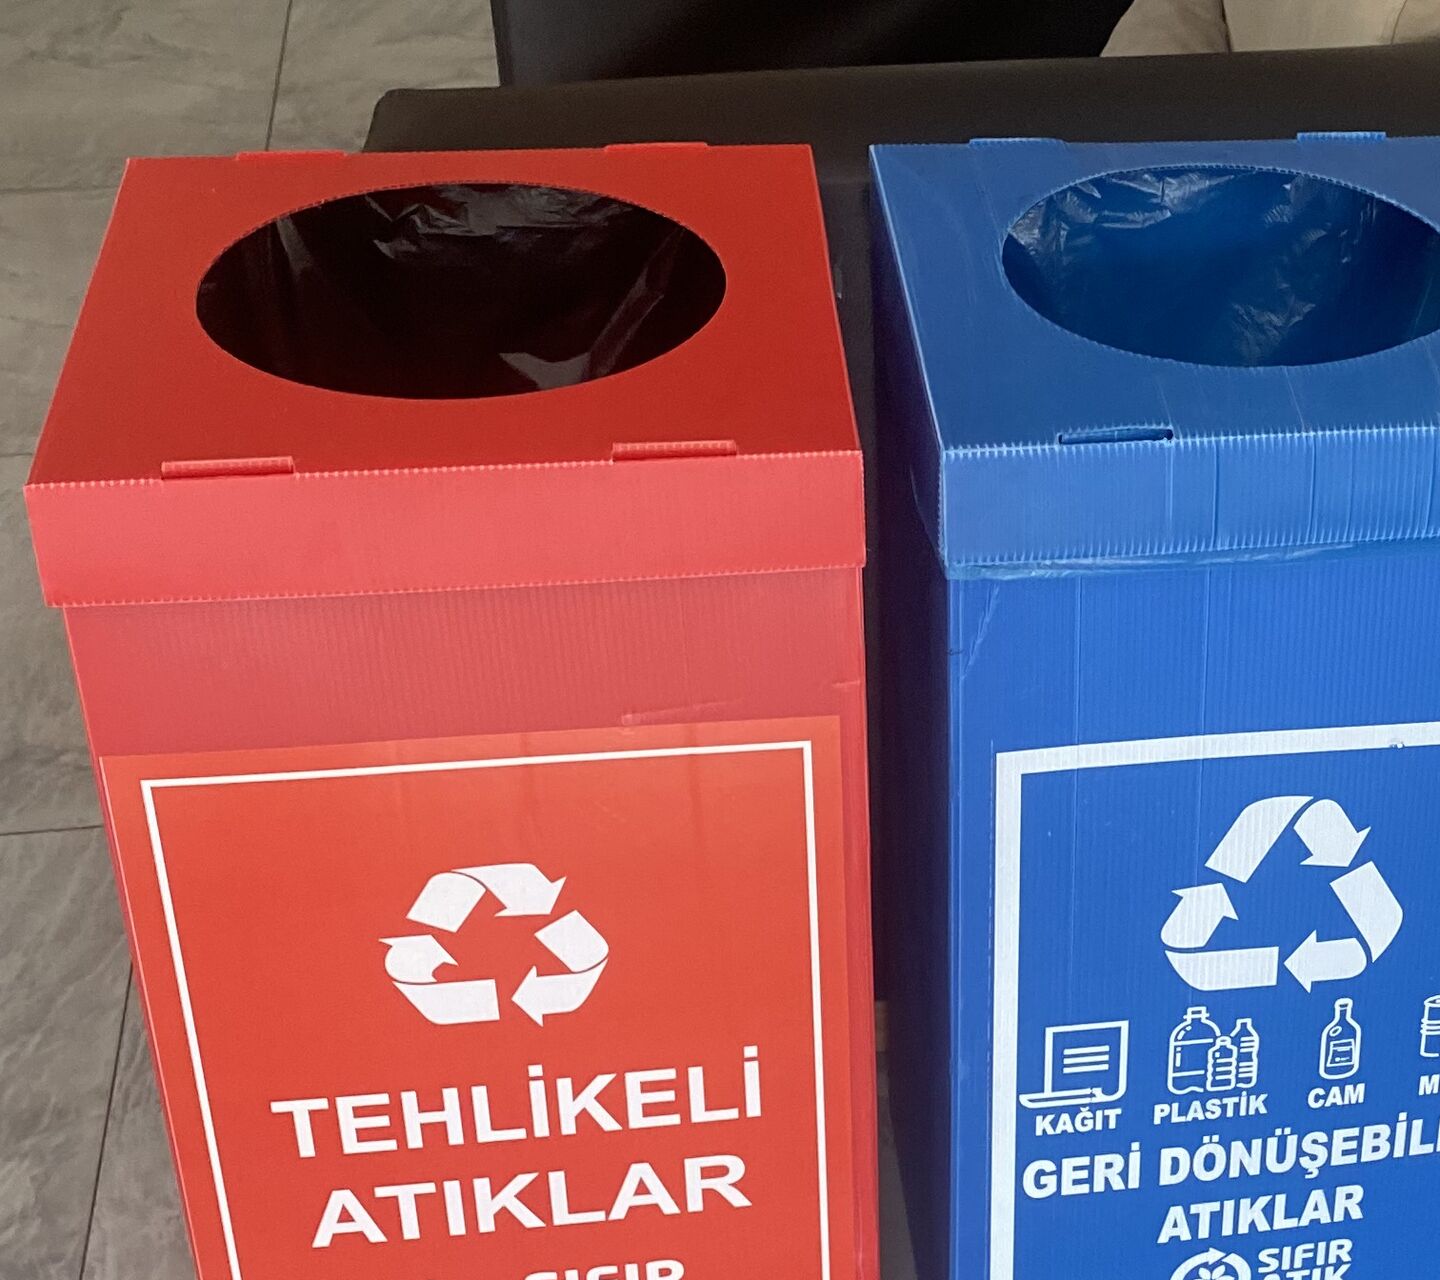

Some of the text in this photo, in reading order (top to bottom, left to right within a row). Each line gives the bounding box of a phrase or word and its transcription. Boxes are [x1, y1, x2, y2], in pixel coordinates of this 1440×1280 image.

[270, 1045, 762, 1158] TEHLİKELİ
[1153, 1091, 1269, 1126] PLASTİK
[1307, 1083, 1366, 1110] CAM
[1035, 1106, 1123, 1137] KAĞIT
[1022, 1141, 1141, 1199] GERİ
[312, 1154, 752, 1248] ATIKLAR
[1157, 1184, 1365, 1244] ATIKLAR
[1257, 1238, 1353, 1273] SIFIR
